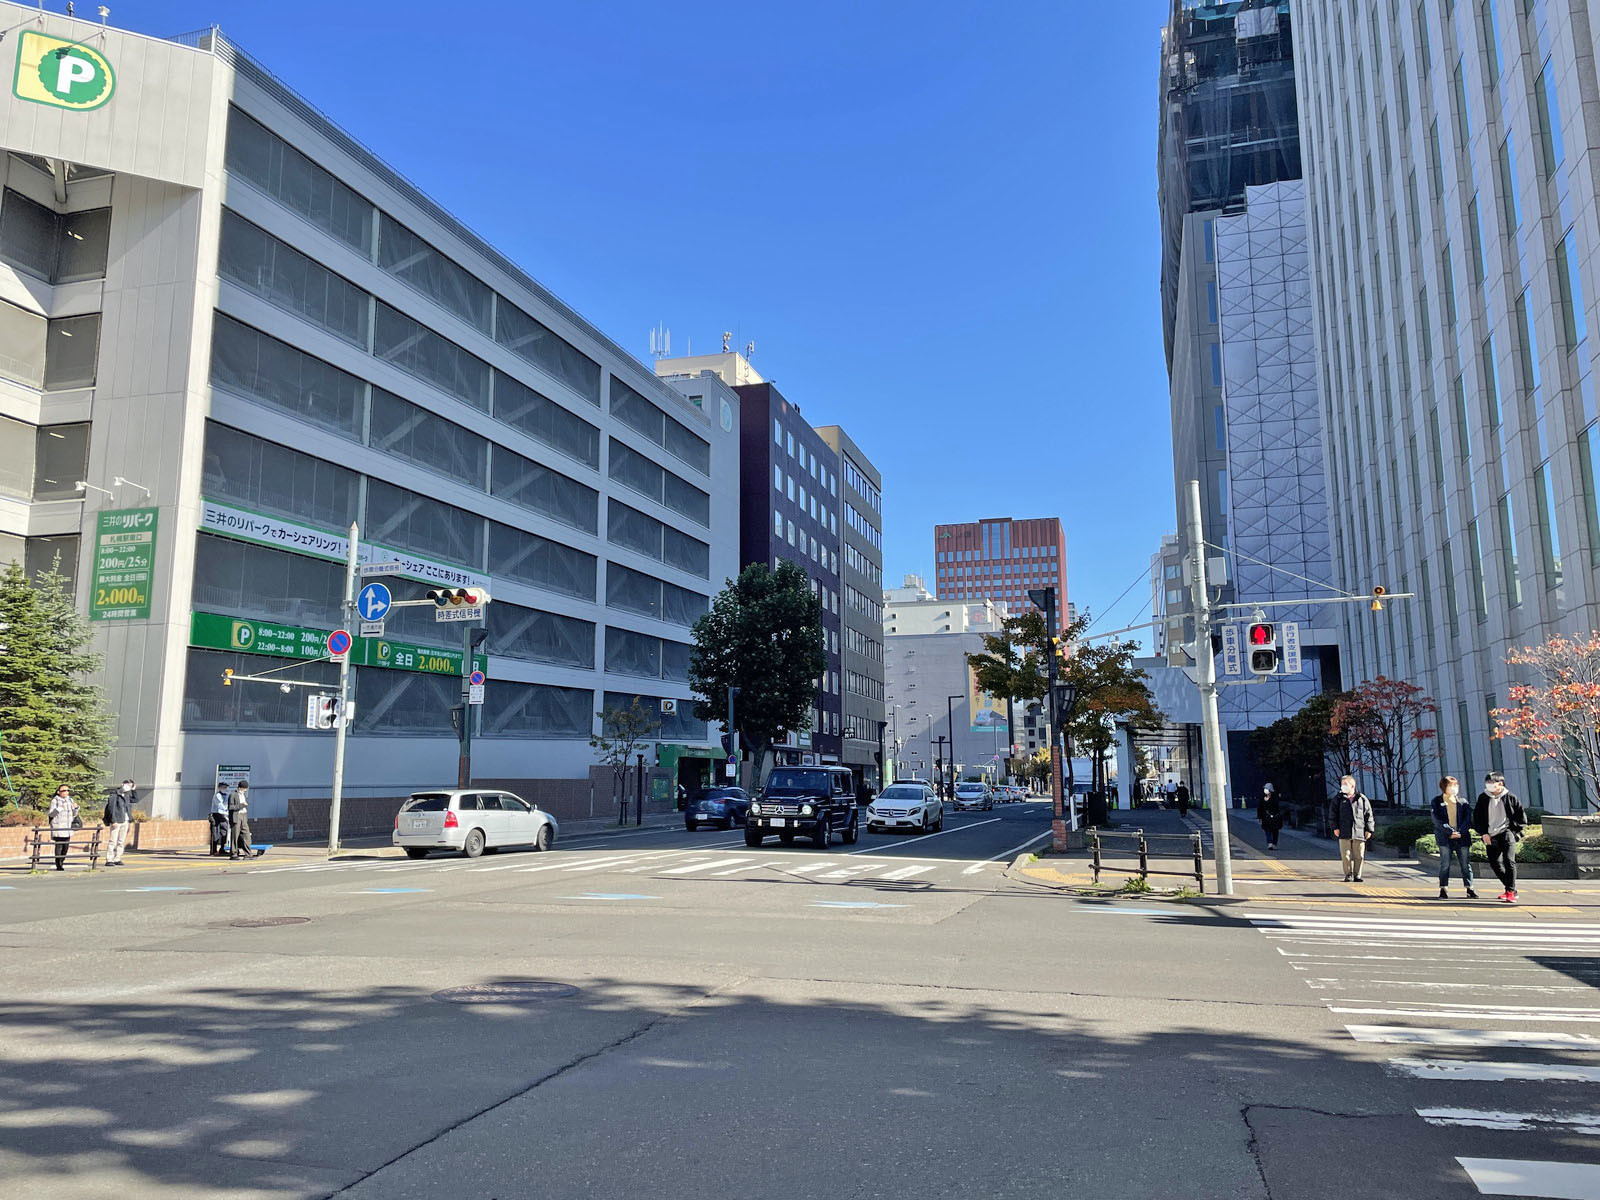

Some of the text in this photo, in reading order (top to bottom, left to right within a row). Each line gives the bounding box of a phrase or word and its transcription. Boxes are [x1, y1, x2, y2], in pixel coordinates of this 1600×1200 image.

[56, 54, 96, 94] P
[438, 608, 481, 620] 時差式信号機
[240, 628, 250, 643] P
[395, 652, 413, 666] 全日
